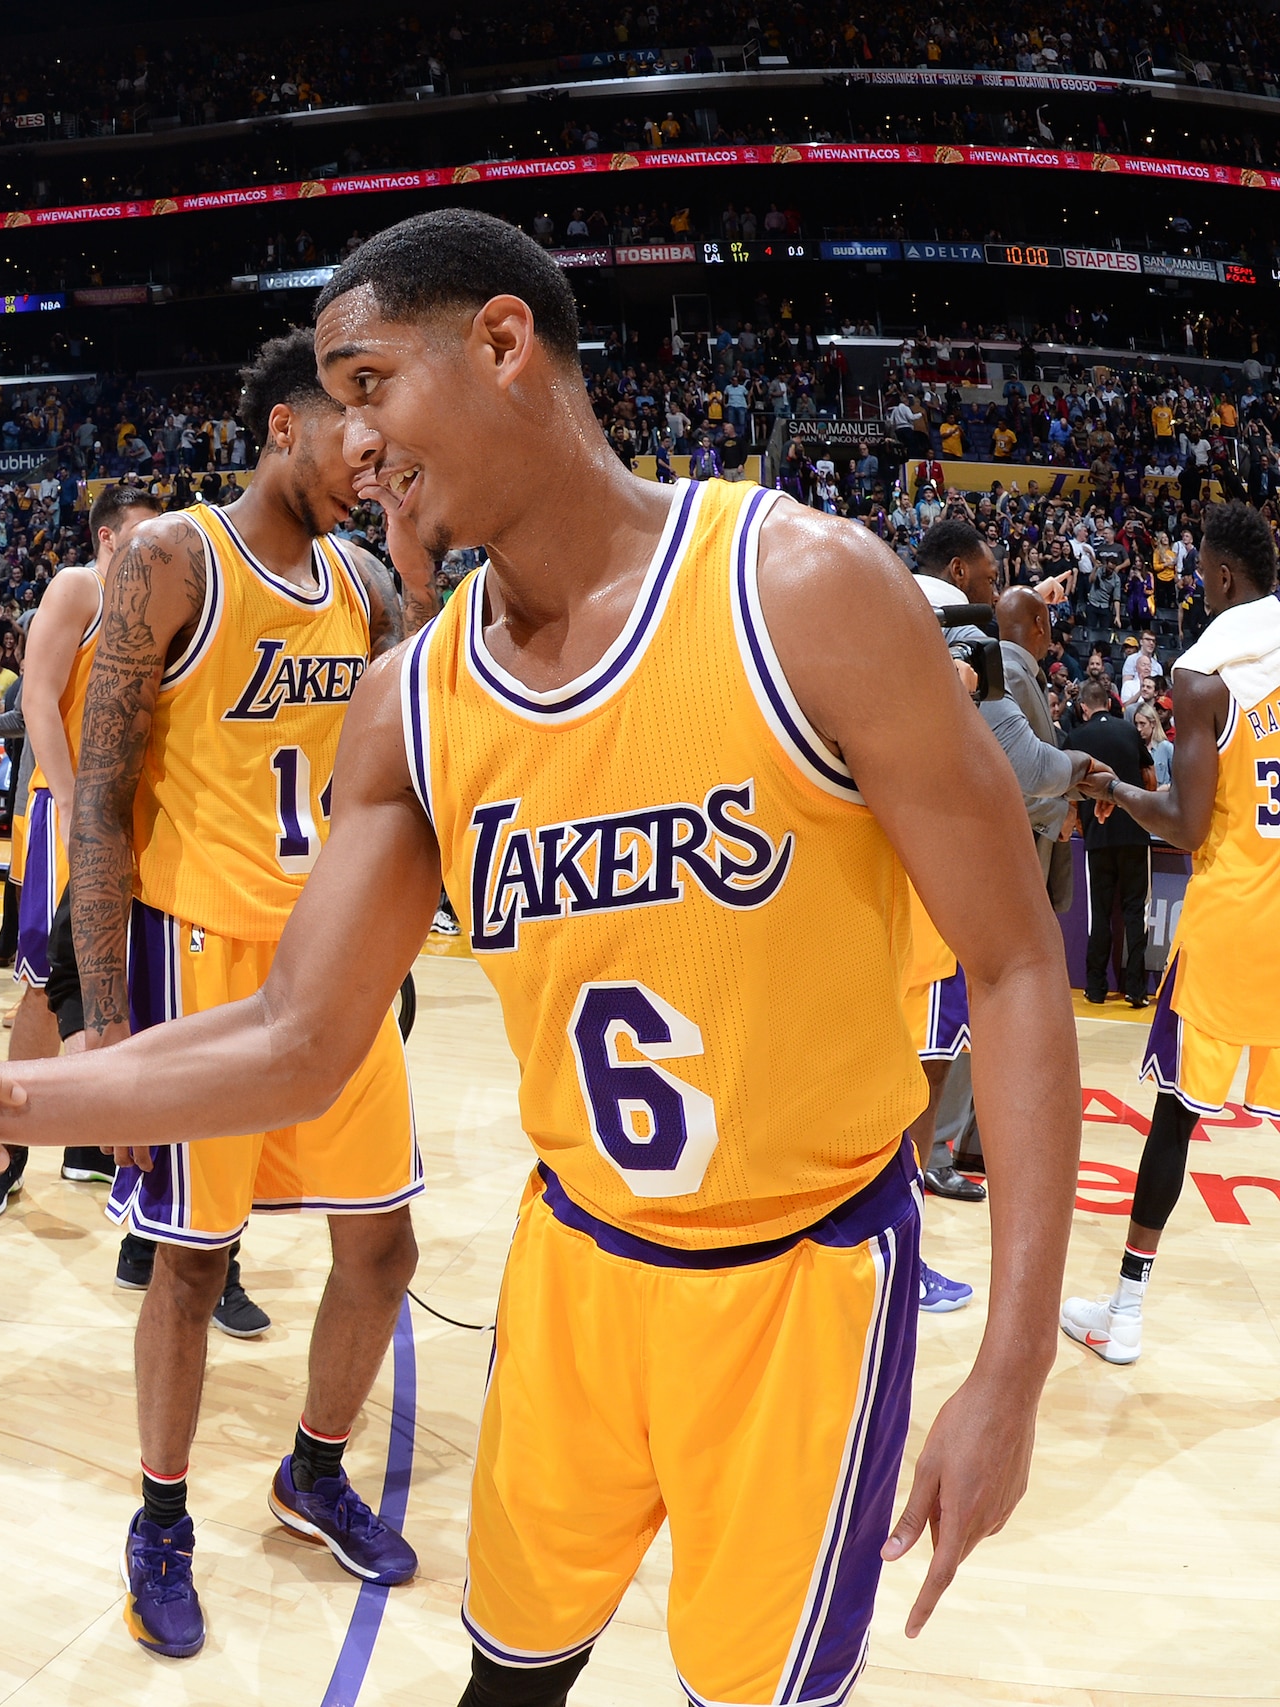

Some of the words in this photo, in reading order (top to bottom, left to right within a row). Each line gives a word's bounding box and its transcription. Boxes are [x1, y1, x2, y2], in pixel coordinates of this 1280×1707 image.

[607, 51, 656, 63] DETA
[872, 73, 919, 84] ASSISTANCE?
[920, 74, 938, 84] TEXT
[981, 75, 1002, 86] ISSUE
[1015, 77, 1050, 88] LOCATION
[1050, 79, 1060, 89] TO
[1061, 80, 1097, 92] 69050
[645, 151, 738, 164] #WEWANTTACOS
[808, 148, 900, 160] #WEWANTTACOS
[970, 151, 1059, 165] #WEWANTTACOS
[486, 161, 576, 177] #WEWANTTACOS
[1125, 159, 1210, 178] #WEWANTTACOS
[332, 175, 420, 191] #WEWANTTACOS
[184, 189, 267, 208] #WEWANTTACOS
[37, 207, 121, 221] #WEWANTTACOS
[617, 247, 694, 261] TOSHIBA
[703, 244, 718, 253] GS
[788, 247, 804, 256] 0.0
[833, 246, 856, 255] BUD
[857, 247, 887, 256] LIGHT
[925, 247, 981, 258] DELTA
[705, 254, 723, 263] LAL
[732, 253, 749, 262] 117
[1066, 250, 1138, 270] STAPLES
[1143, 255, 1164, 266] SAN
[1173, 259, 1215, 272] MANUEL
[40, 301, 61, 311] NBA
[789, 422, 818, 434] SAN
[827, 422, 884, 435] MANUEL
[469, 777, 796, 954] LAKERS
[566, 980, 720, 1198] 6
